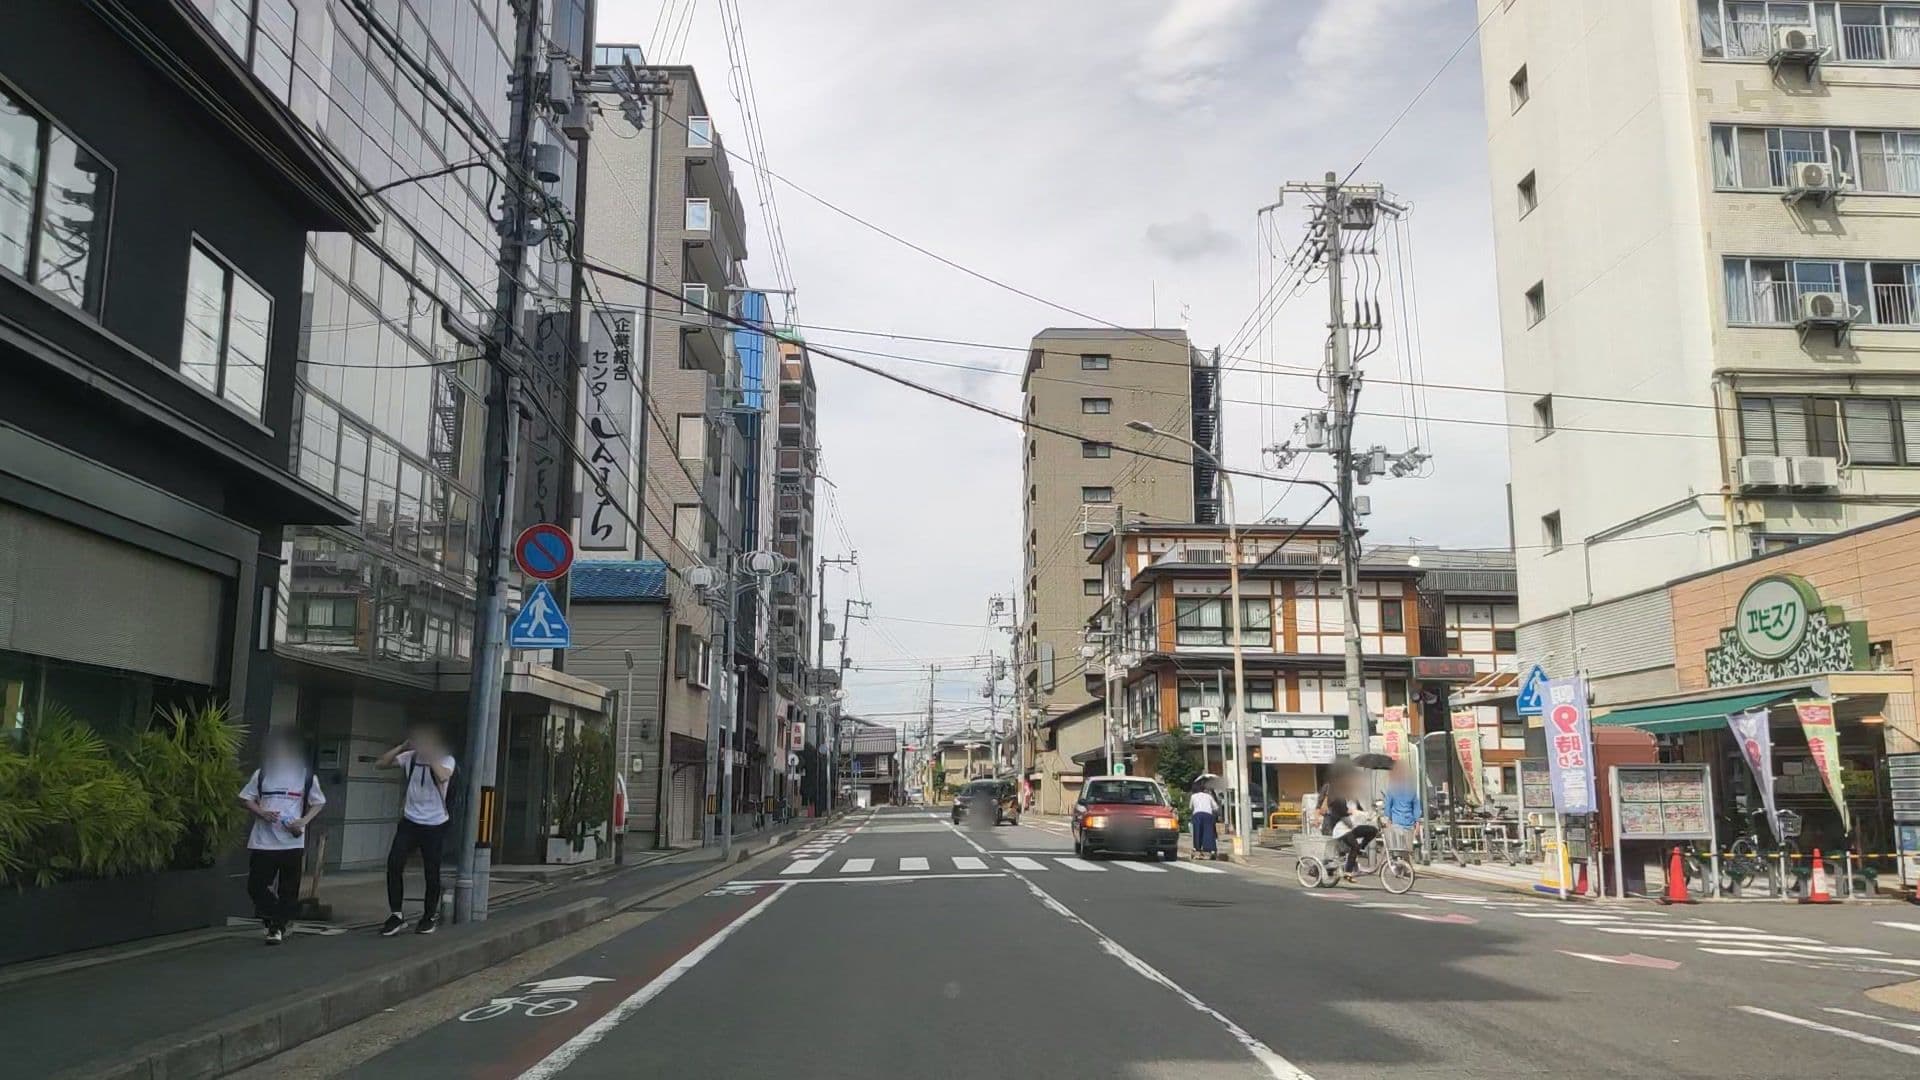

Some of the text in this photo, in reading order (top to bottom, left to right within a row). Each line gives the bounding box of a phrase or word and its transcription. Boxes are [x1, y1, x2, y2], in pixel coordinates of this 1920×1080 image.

[592, 349, 609, 412] センター
[614, 317, 631, 381] 企業組合
[590, 416, 624, 541] しんまち
[1200, 709, 1210, 721] P
